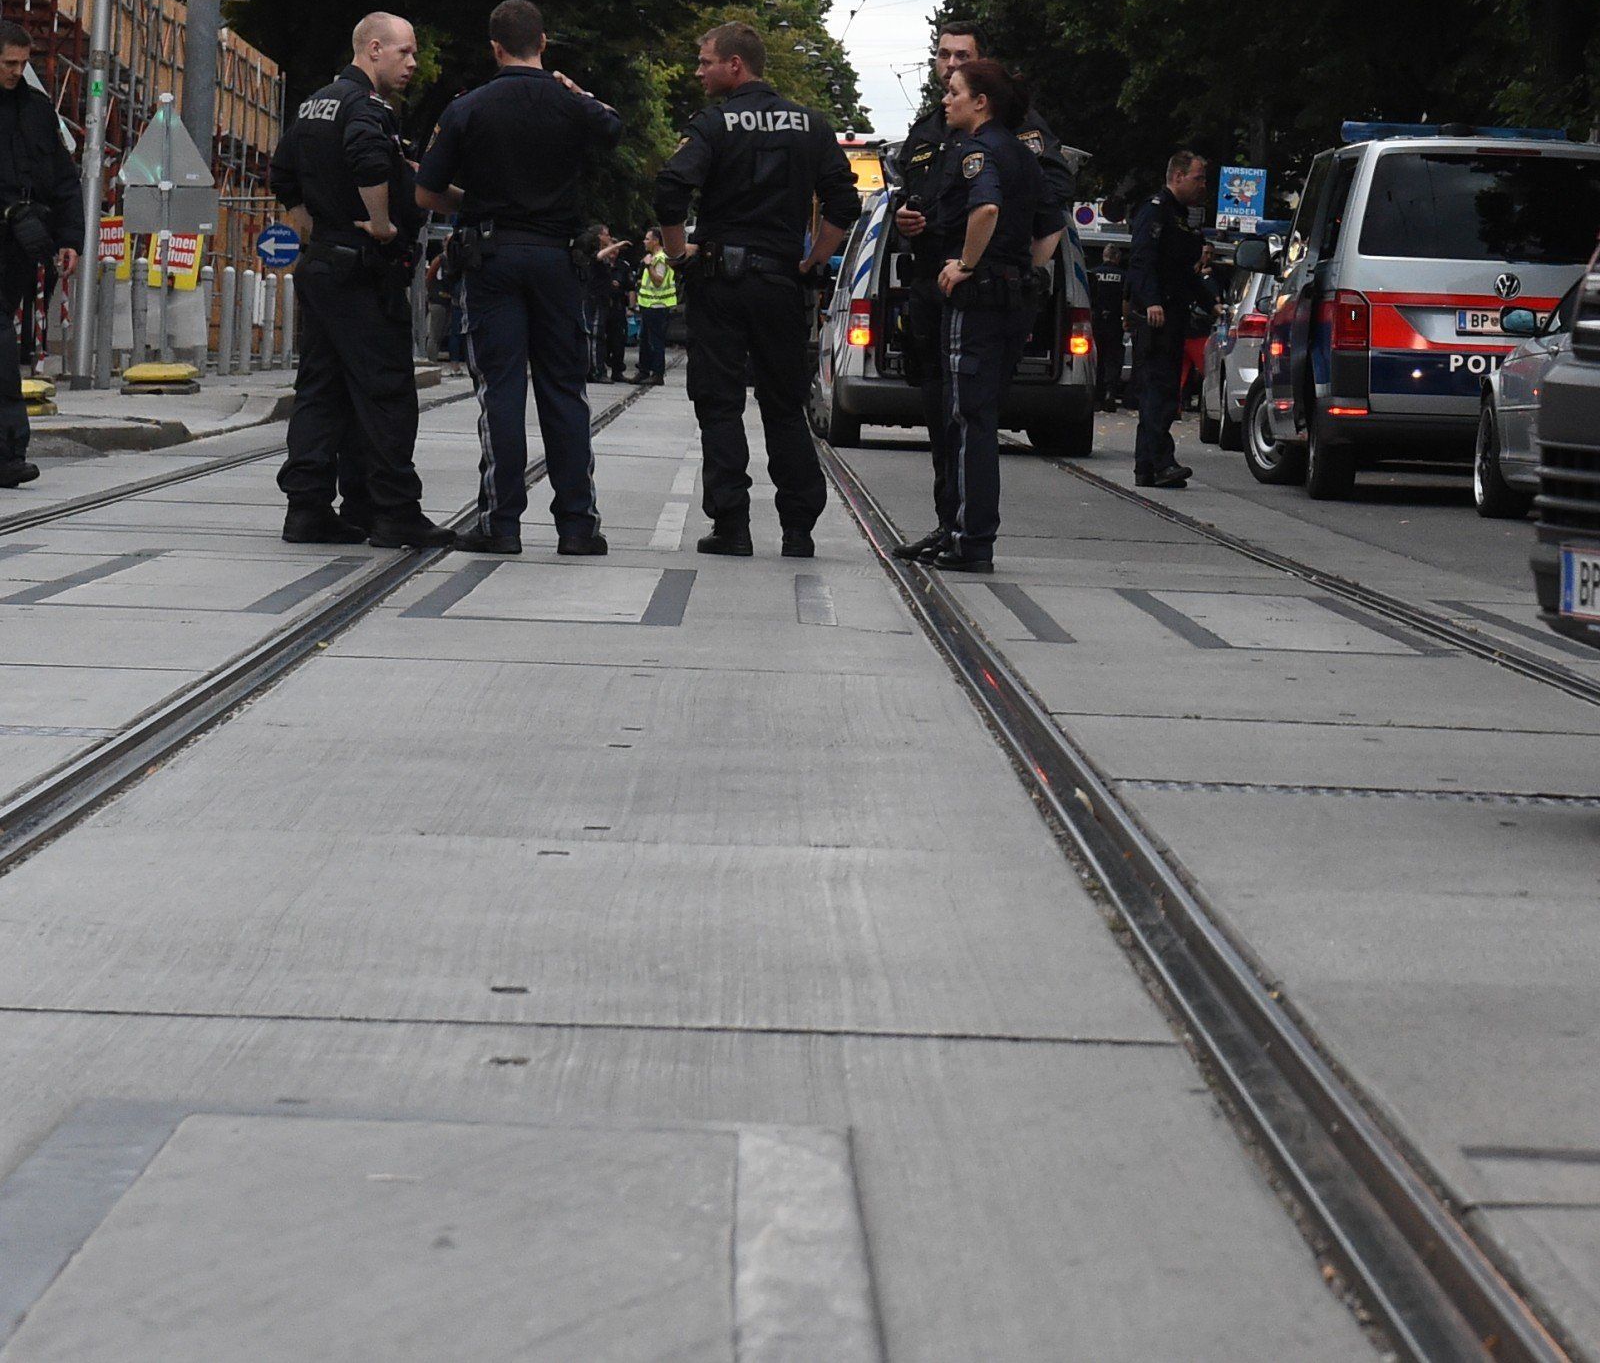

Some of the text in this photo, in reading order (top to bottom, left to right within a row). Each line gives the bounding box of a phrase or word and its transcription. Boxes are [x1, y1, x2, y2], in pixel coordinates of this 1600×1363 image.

[723, 110, 810, 132] POLIZEI
[1223, 166, 1265, 177] VORSICHT
[1224, 206, 1256, 216] KINDER
[1471, 314, 1489, 328] BP
